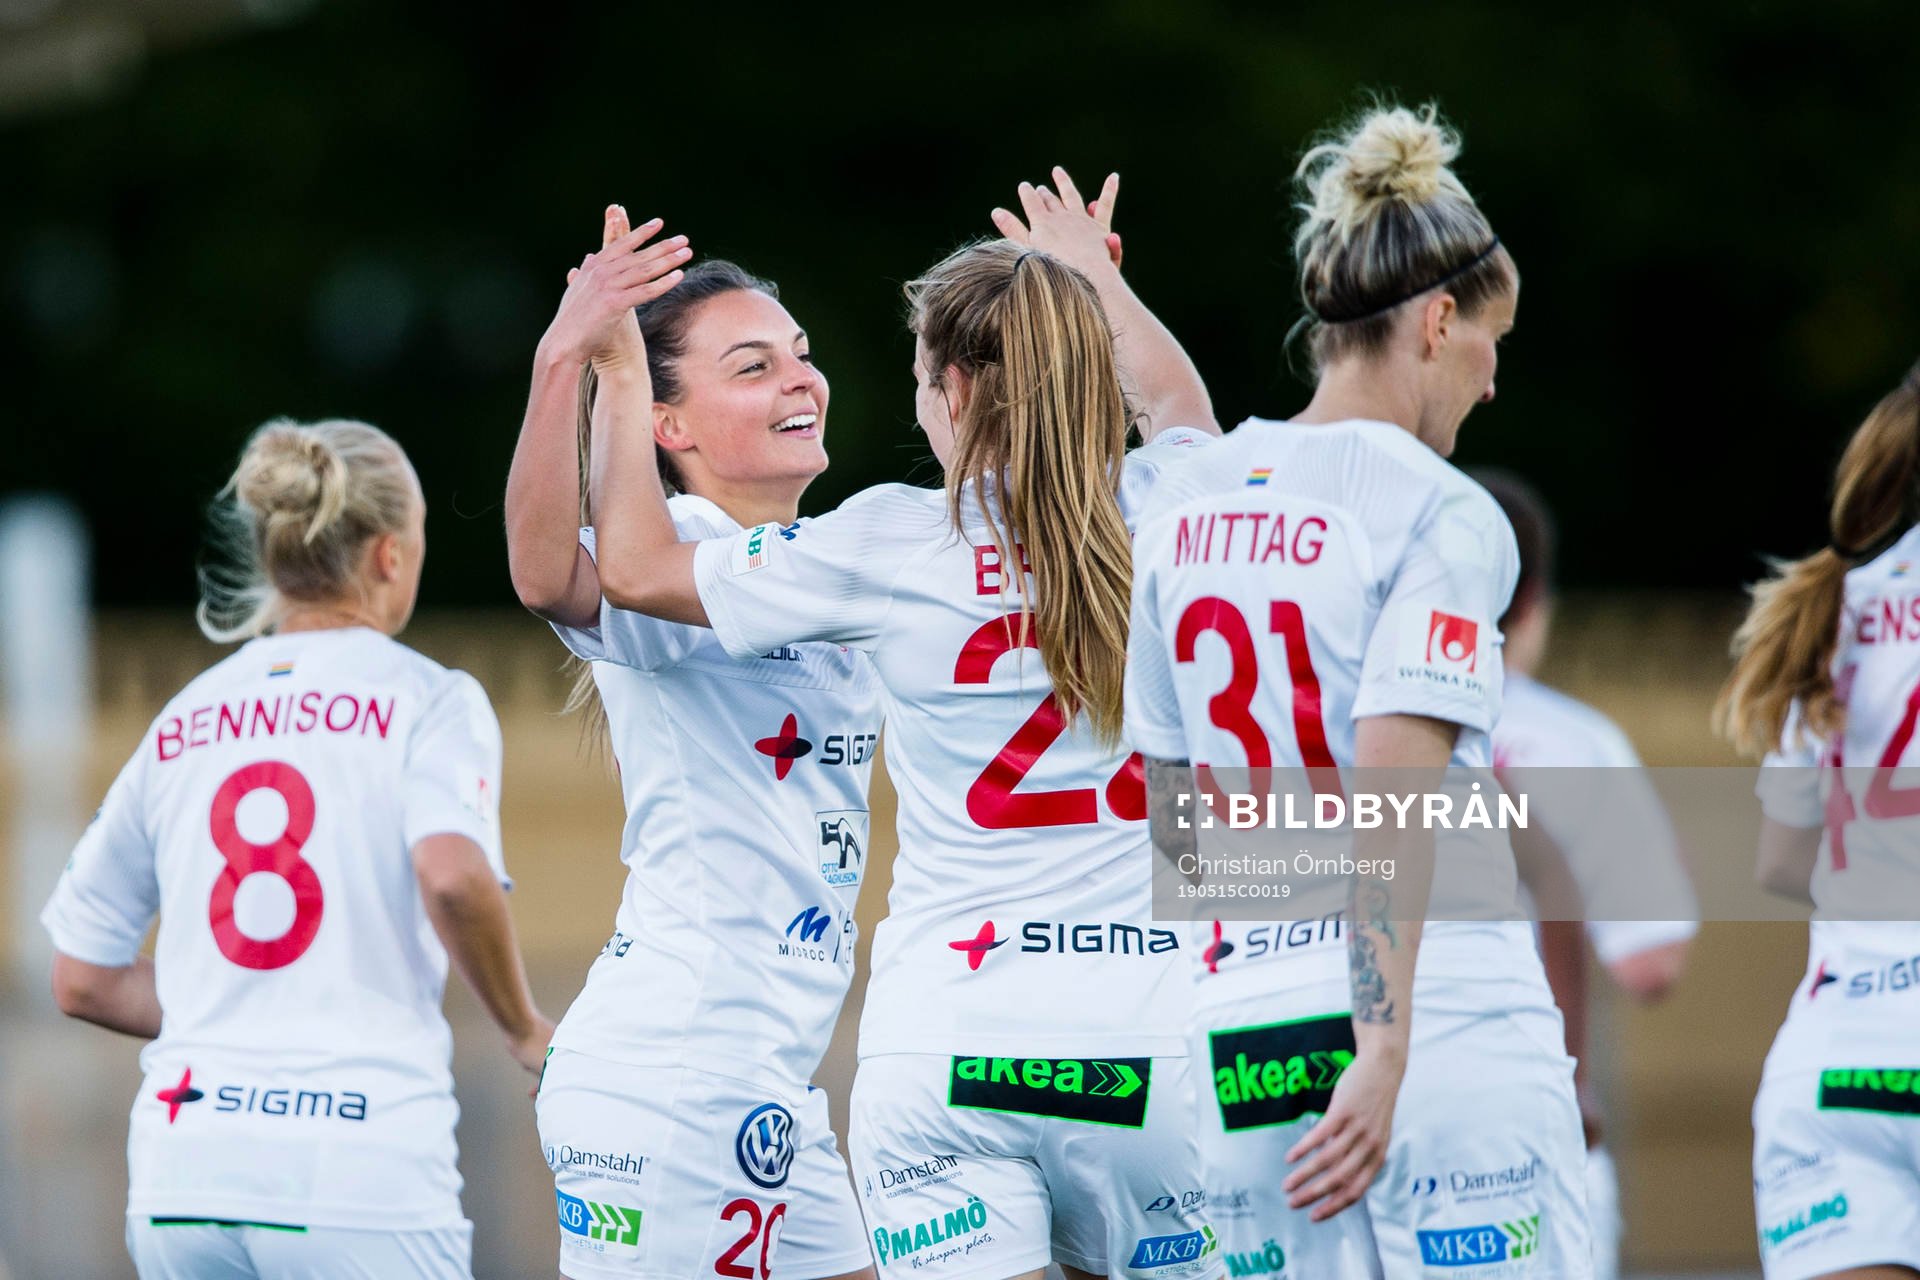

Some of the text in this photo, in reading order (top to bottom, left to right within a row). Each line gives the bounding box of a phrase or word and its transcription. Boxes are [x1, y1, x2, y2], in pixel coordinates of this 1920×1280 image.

[1174, 513, 1329, 567] MITTAG
[157, 691, 395, 762] BENNISON
[1175, 596, 1347, 831] 31
[208, 760, 324, 970] 8
[778, 944, 825, 962] MIDROC
[956, 1056, 1084, 1094] akea
[1216, 1052, 1312, 1105] akea
[560, 1145, 644, 1175] Damstahl
[1141, 1236, 1199, 1265] MKB
[1427, 1231, 1498, 1261] MKB
